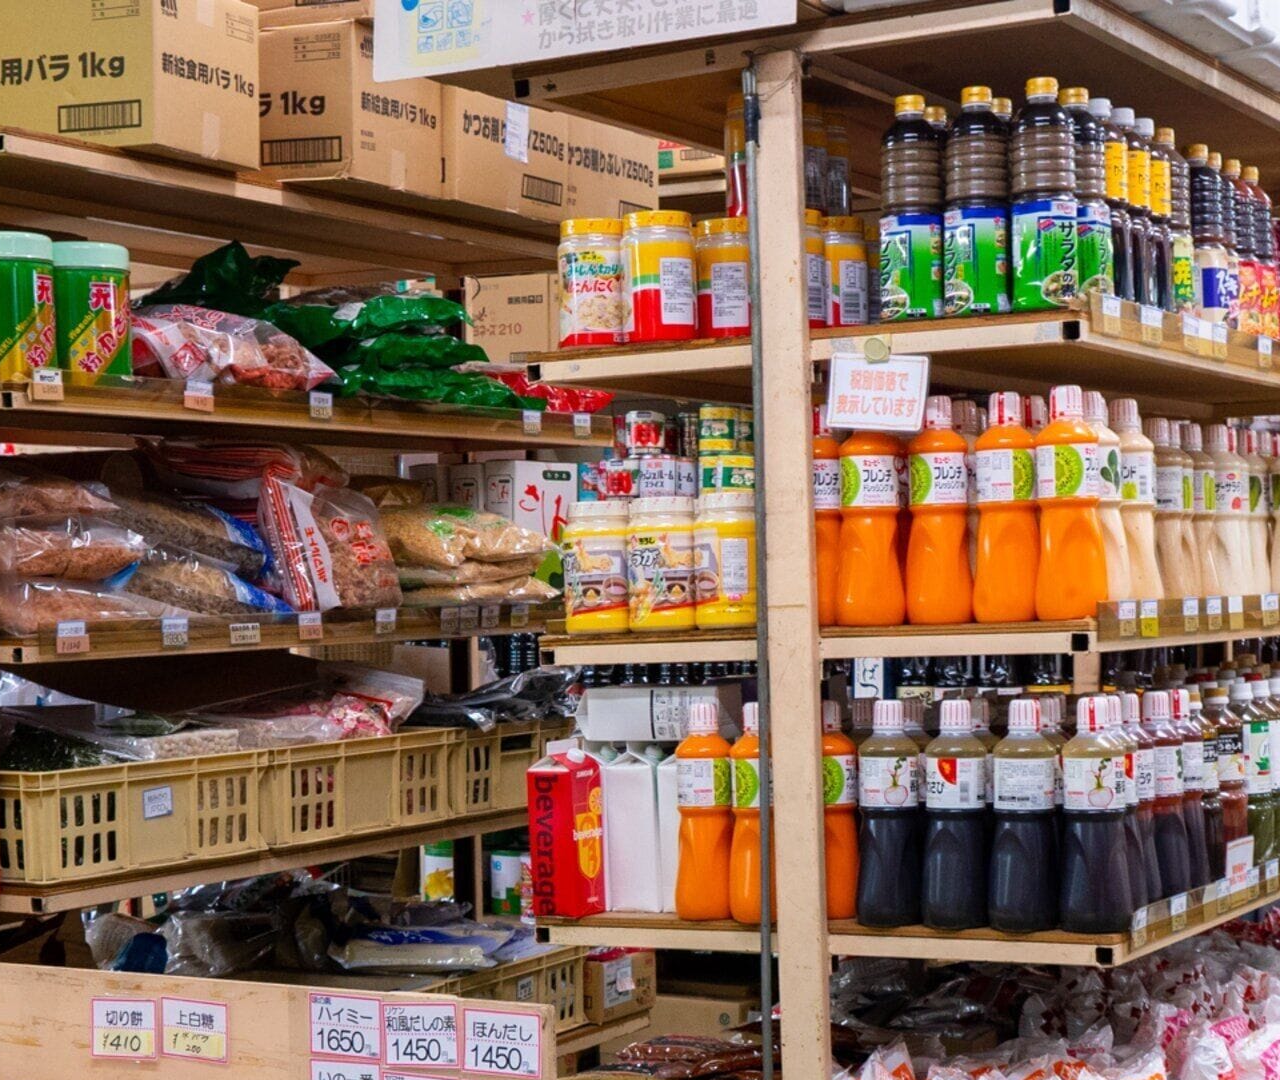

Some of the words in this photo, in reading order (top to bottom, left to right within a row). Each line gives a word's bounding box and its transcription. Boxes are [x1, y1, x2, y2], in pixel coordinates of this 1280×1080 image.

[81, 51, 125, 79] 1kg
[162, 53, 231, 90] 新給食用バラ
[233, 74, 255, 98] 1kg
[281, 91, 326, 116] 1kg
[835, 396, 918, 417] 表示しています
[862, 470, 893, 483] フレンチ
[933, 467, 963, 480] フレンチ
[533, 774, 558, 916] beverage
[105, 1010, 143, 1028] 切り餅
[176, 1010, 215, 1030] 上白糖
[318, 1007, 373, 1024] ハイミー
[386, 1016, 456, 1032] 和風だしの素
[317, 1028, 365, 1053] 1650
[472, 1022, 533, 1042] ほんだし
[392, 1038, 441, 1061] 1450
[471, 1044, 522, 1071] 1450
